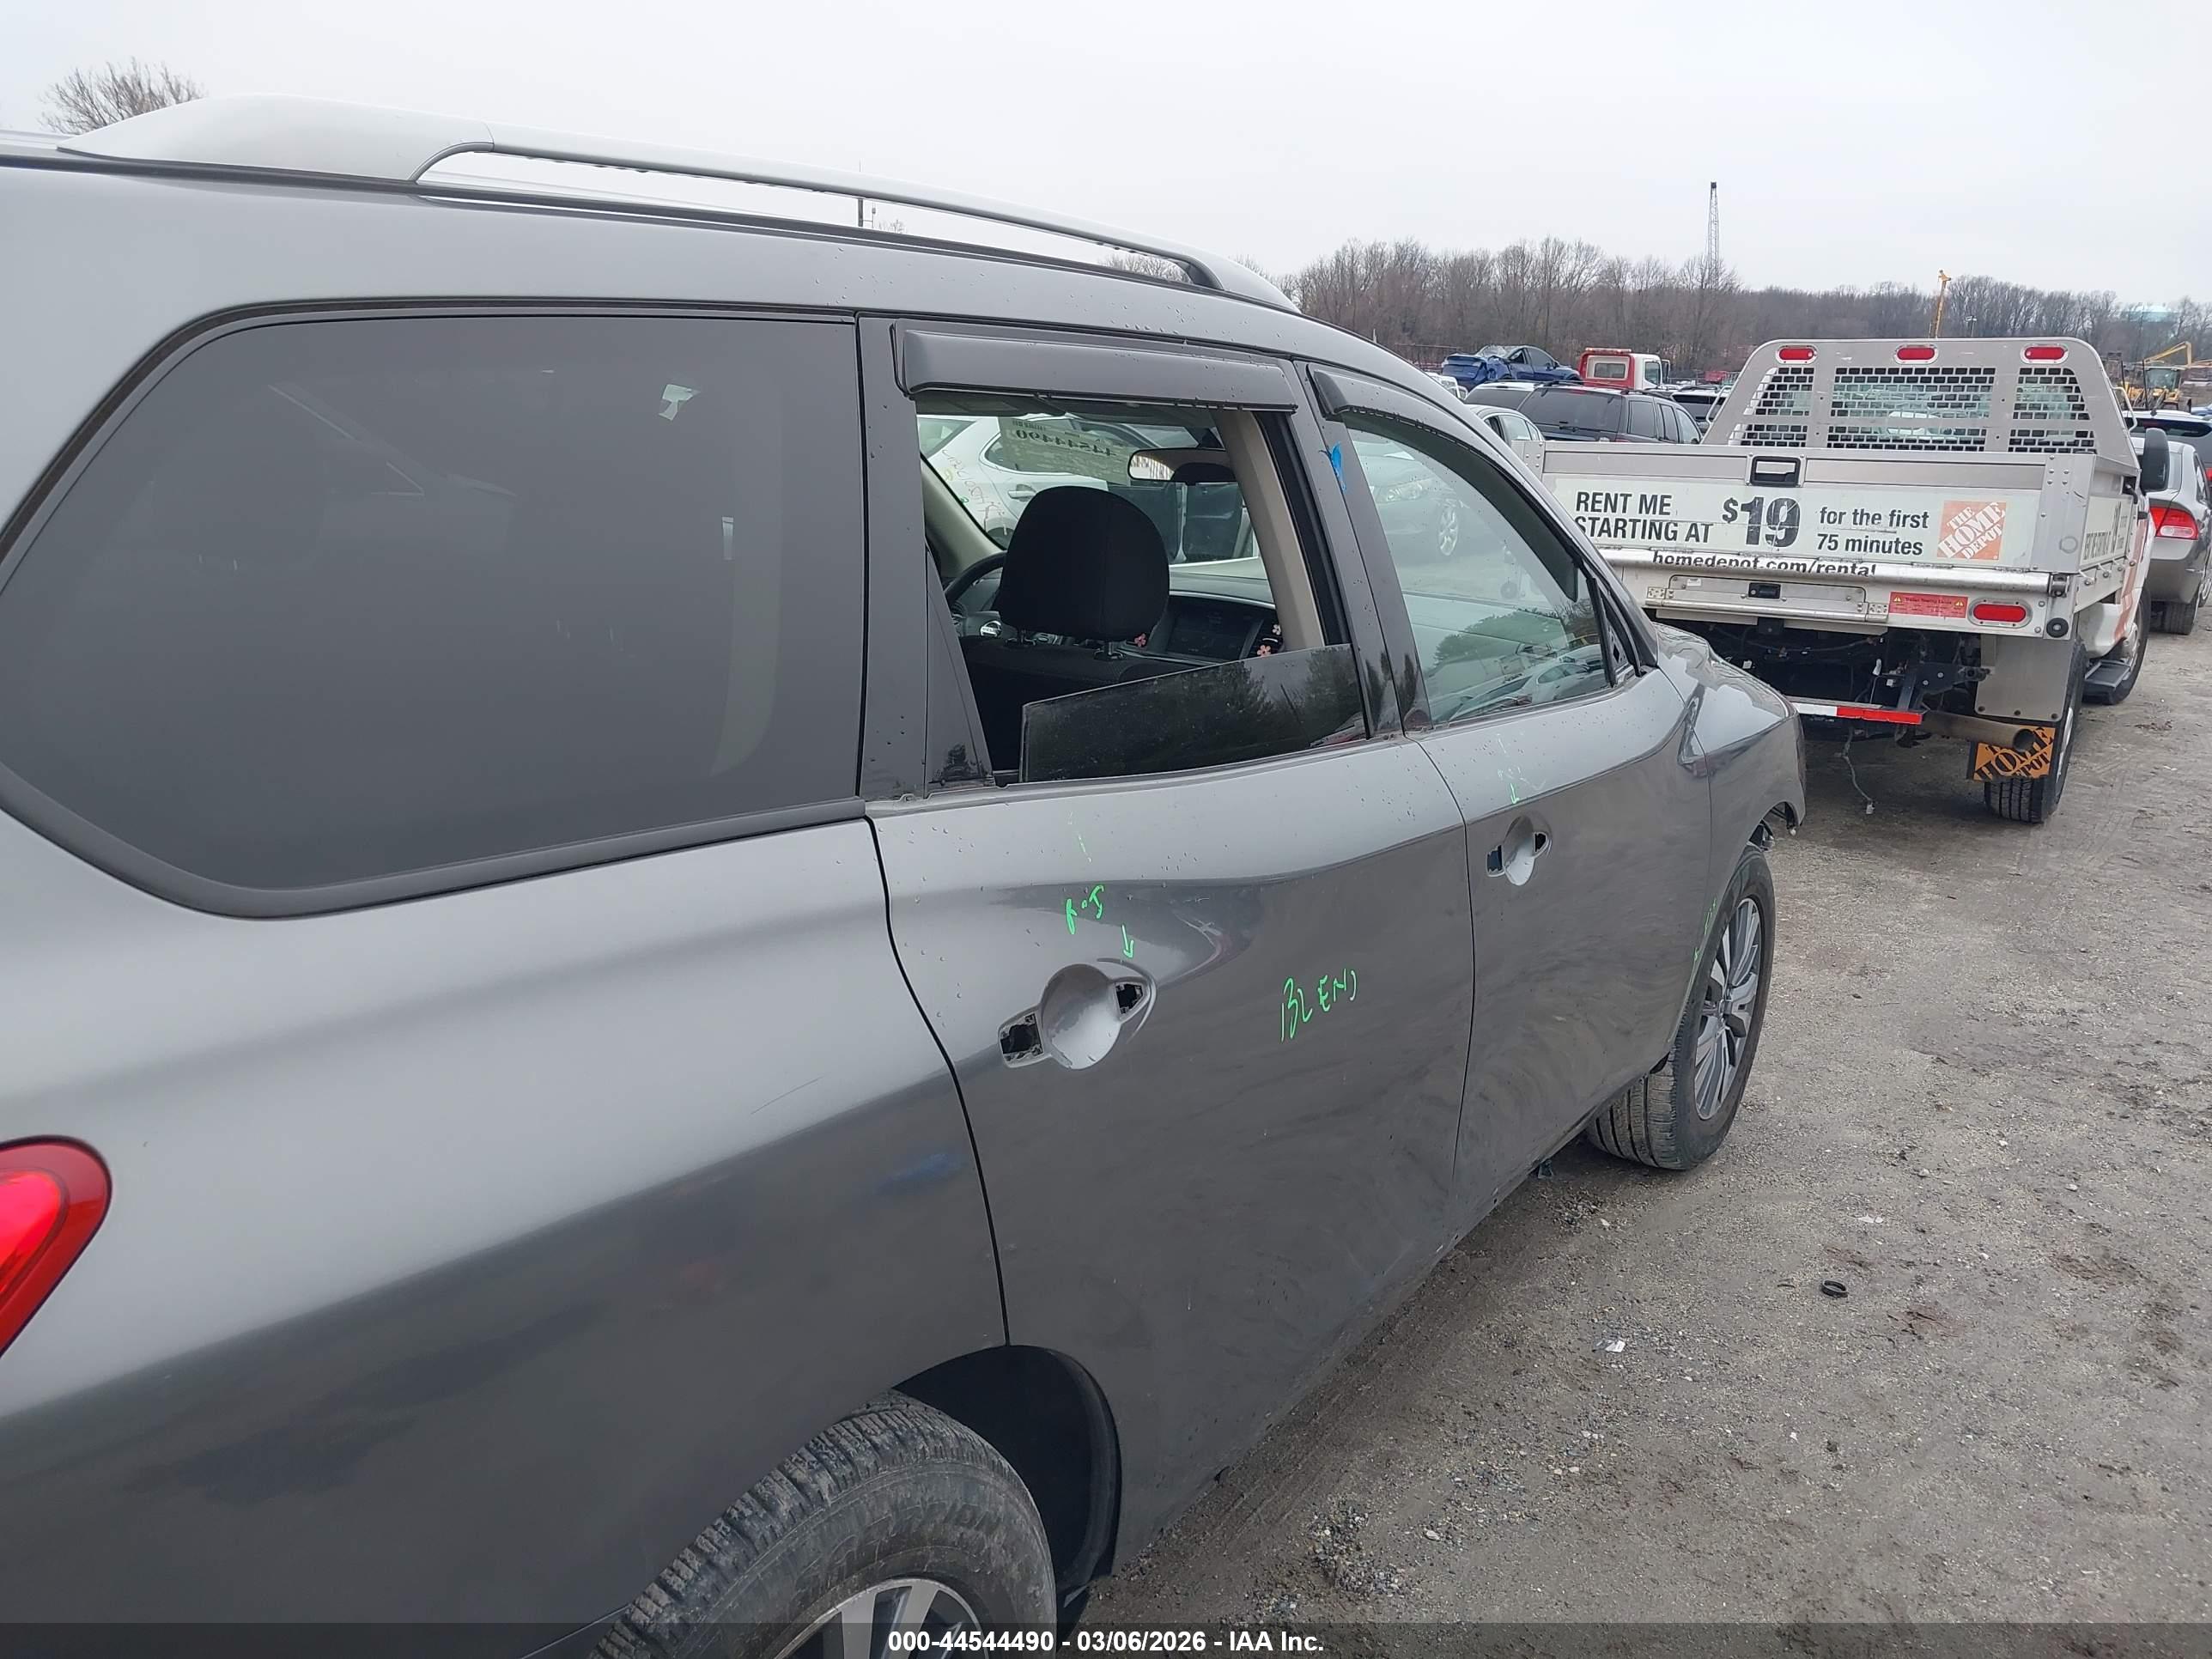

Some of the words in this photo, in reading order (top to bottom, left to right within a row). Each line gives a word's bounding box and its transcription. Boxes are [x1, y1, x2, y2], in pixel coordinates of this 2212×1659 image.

[1576, 491, 1632, 514] RENT
[1638, 494, 1672, 515] ME
[1575, 516, 1678, 542] STARTING
[1685, 522, 1713, 543] AT
[1722, 496, 1801, 548] $19
[1820, 507, 1846, 526] for
[1852, 508, 1882, 526] the
[1888, 509, 1929, 529] first
[1938, 502, 2005, 558] HOME
[1946, 507, 1975, 530] THE
[1817, 533, 1839, 551] 75
[1844, 535, 1923, 556] minutes
[1961, 523, 2002, 559] DEPOT
